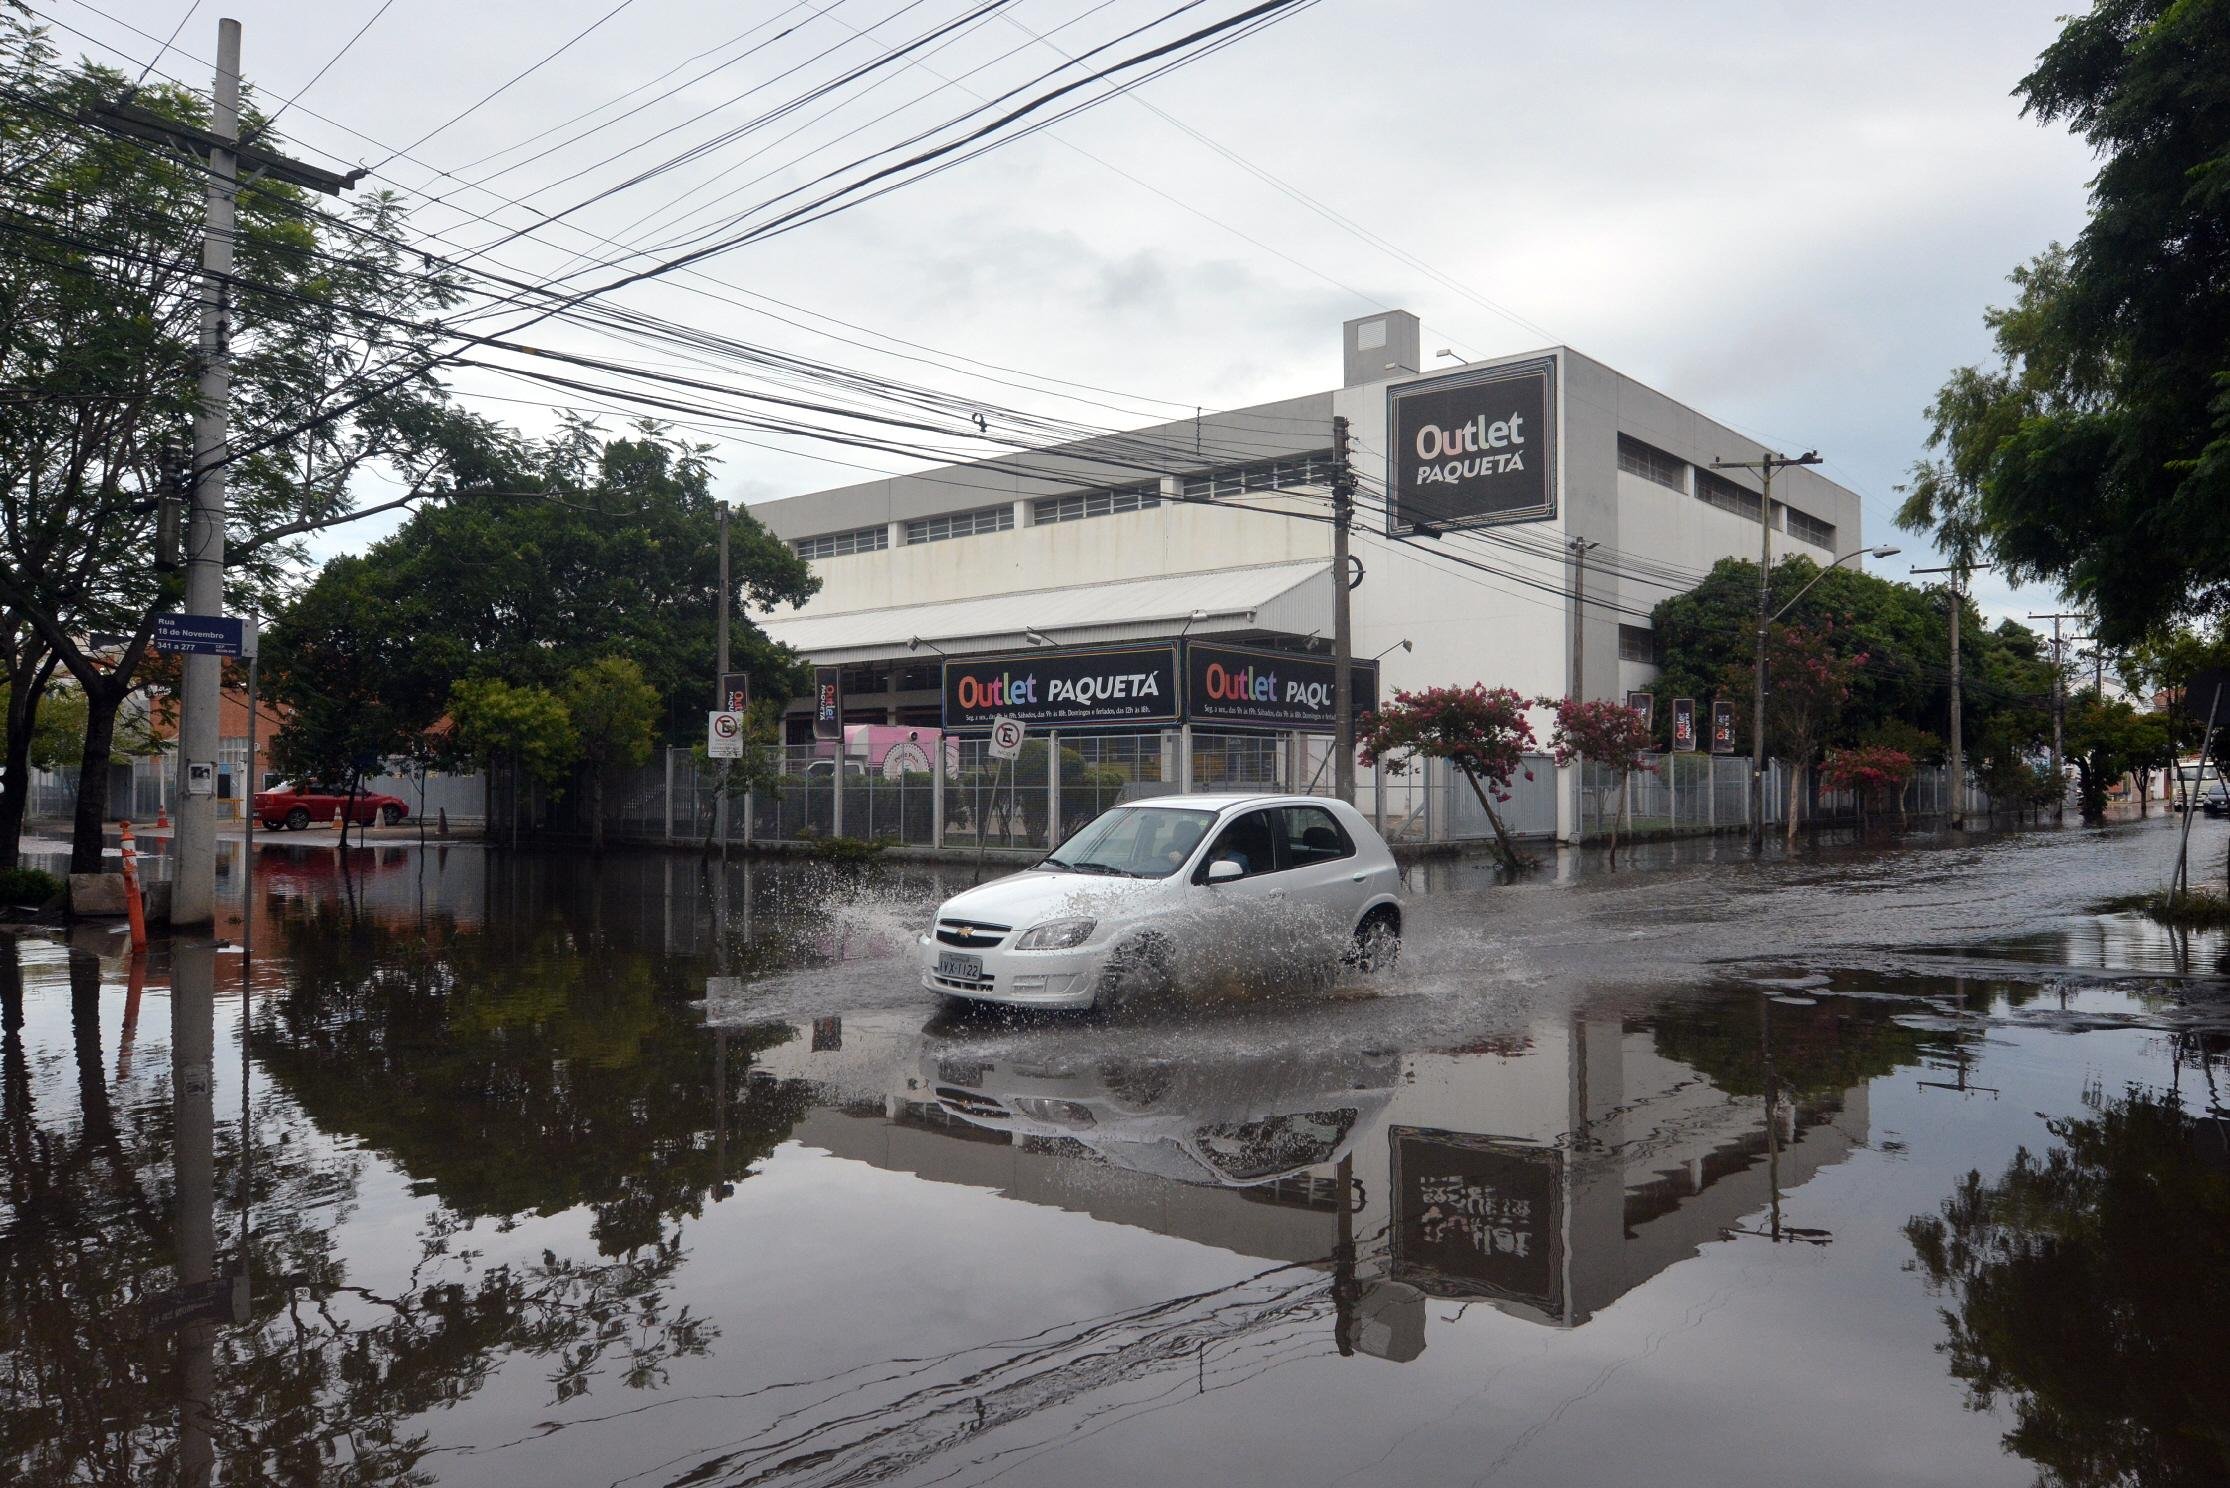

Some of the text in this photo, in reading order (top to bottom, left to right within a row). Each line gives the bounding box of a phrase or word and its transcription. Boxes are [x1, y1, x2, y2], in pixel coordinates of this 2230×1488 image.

[1416, 410, 1525, 460] Outlet
[1416, 450, 1525, 485] PAQUETÁ
[158, 618, 175, 626] Rua
[182, 629, 225, 639] Novembro
[157, 641, 171, 649] 341
[181, 643, 196, 651] 277
[958, 670, 1160, 709] Outlet PAQUETÁ
[1206, 662, 1335, 710] Outlet PAQU
